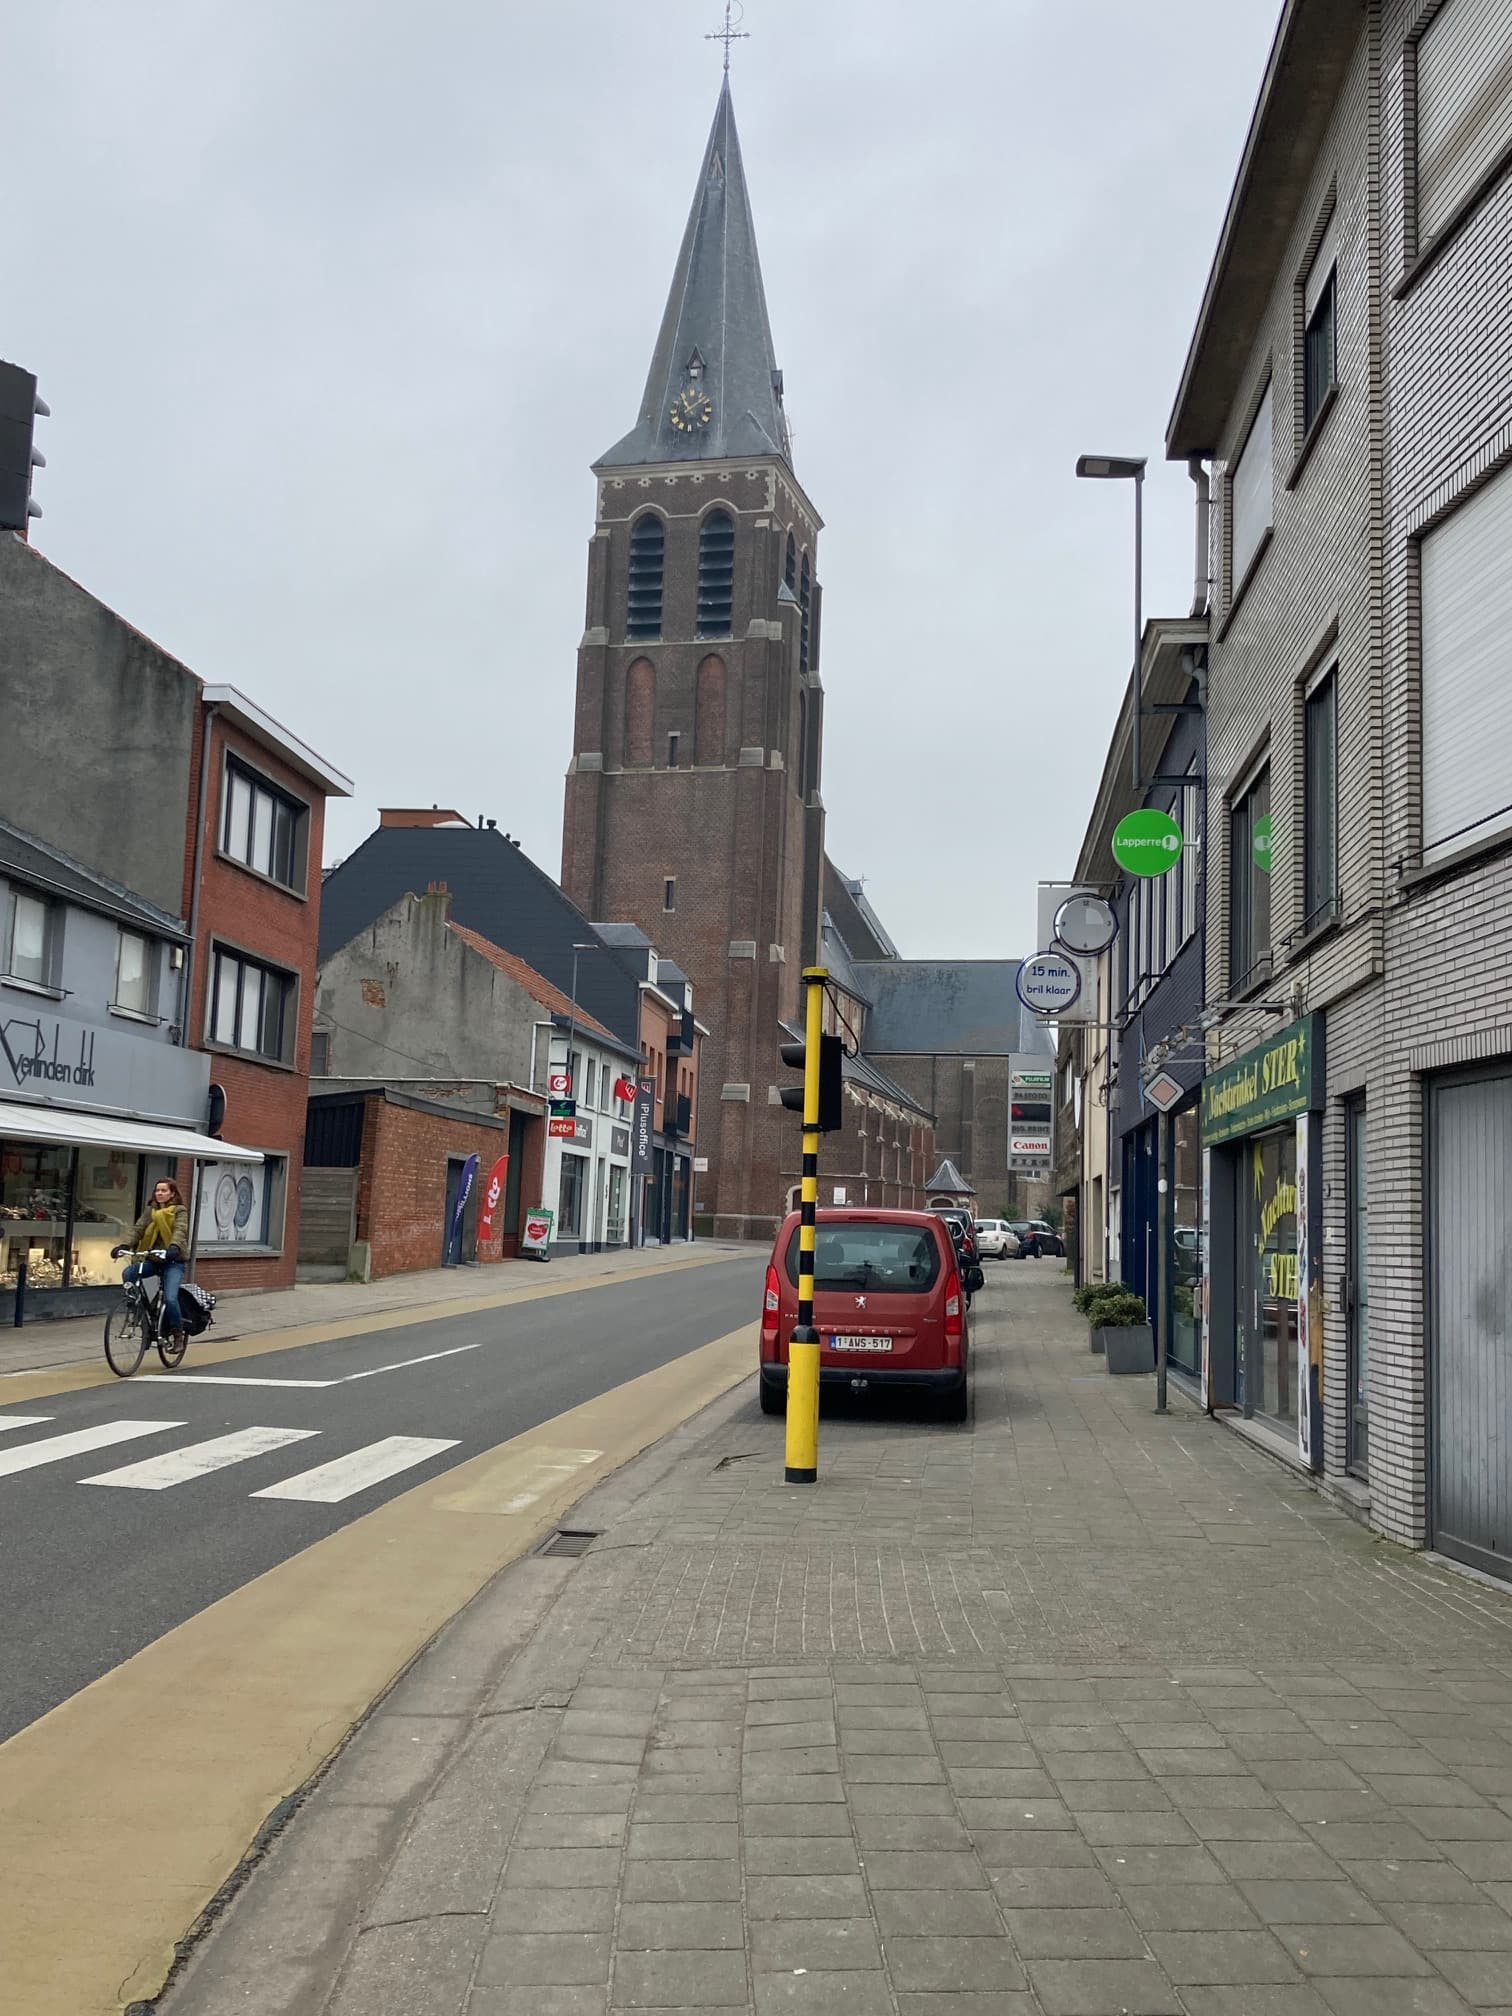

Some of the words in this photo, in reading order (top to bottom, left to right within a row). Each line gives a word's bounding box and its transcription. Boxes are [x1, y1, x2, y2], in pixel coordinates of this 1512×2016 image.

[1116, 836, 1162, 848] Lapperre
[1031, 965, 1045, 977] 15
[1047, 966, 1071, 978] min.
[1026, 984, 1043, 995] bril
[1045, 985, 1071, 996] klaar
[73, 1029, 95, 1087] dirk
[1262, 1038, 1298, 1095] STER
[1013, 1141, 1048, 1150] Canon
